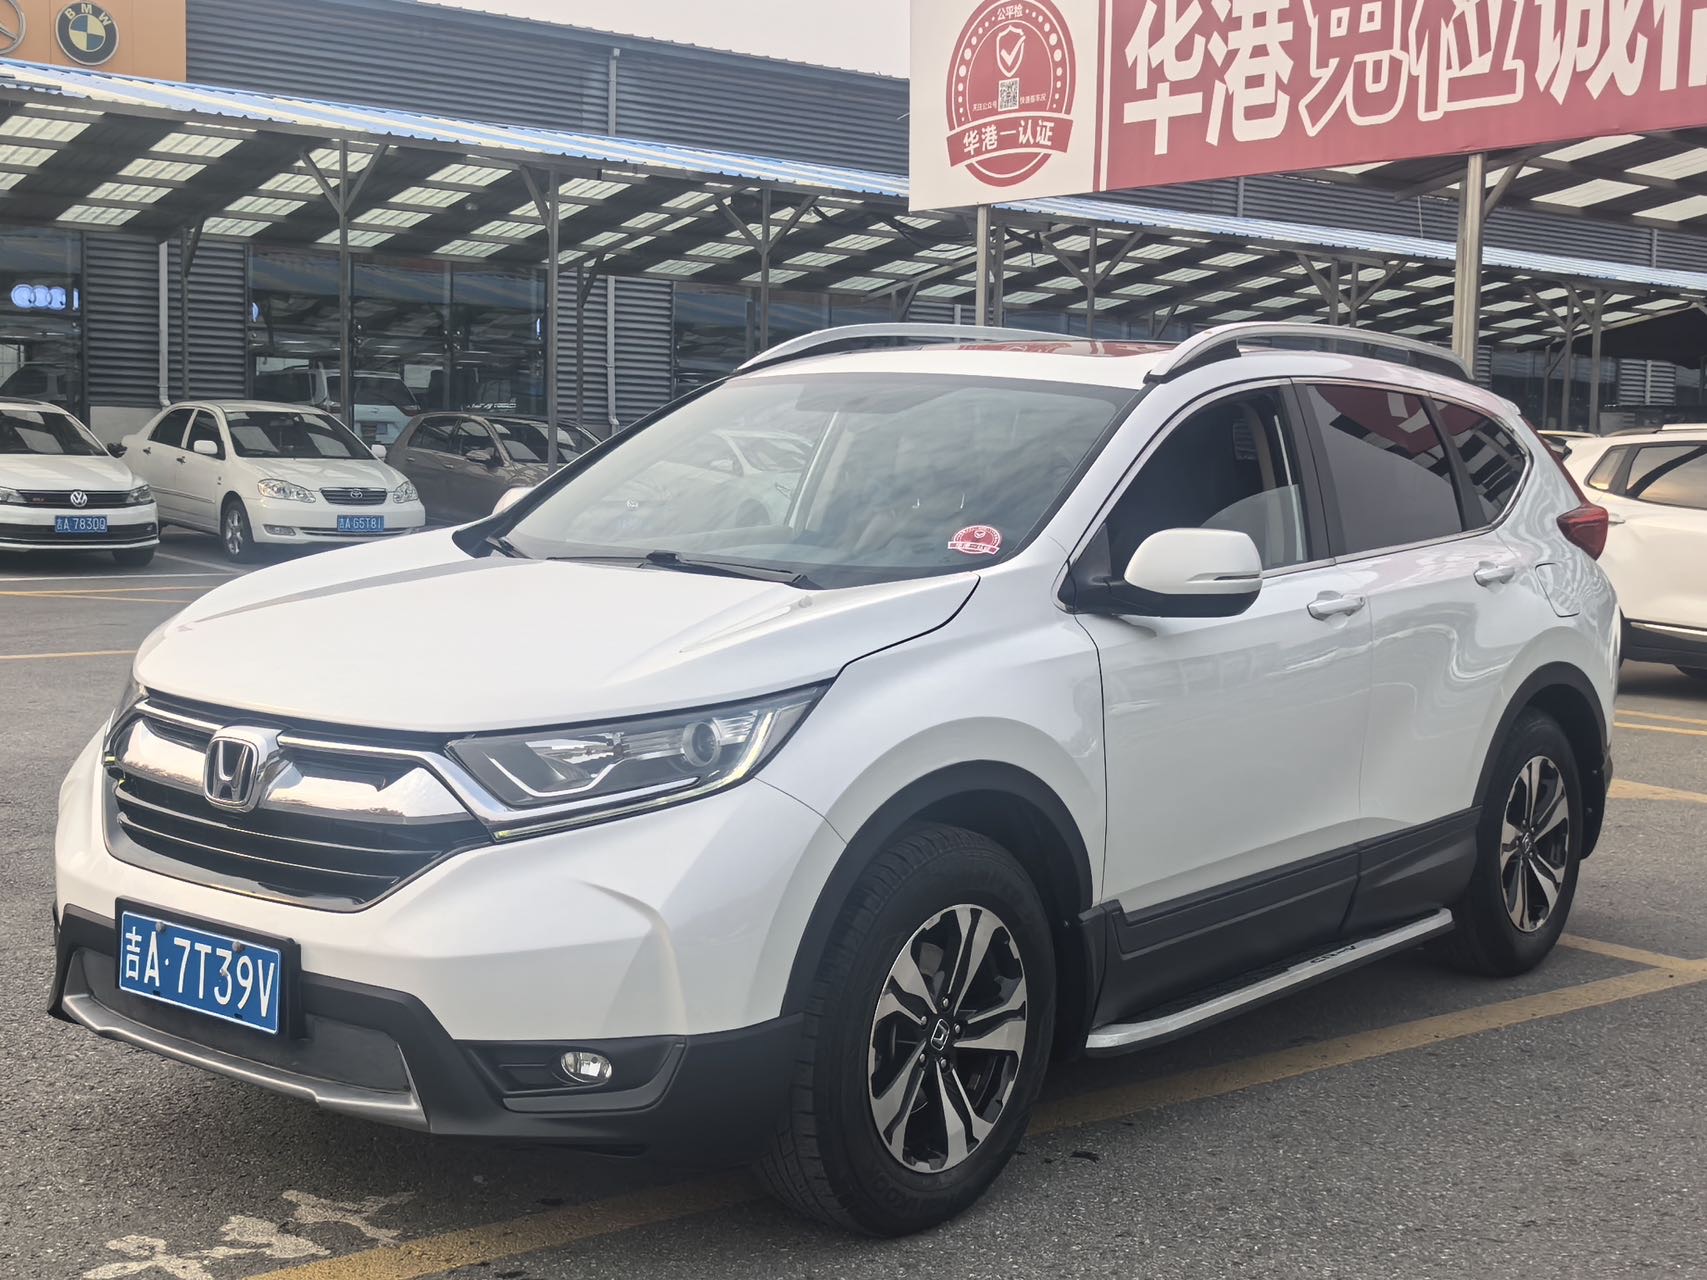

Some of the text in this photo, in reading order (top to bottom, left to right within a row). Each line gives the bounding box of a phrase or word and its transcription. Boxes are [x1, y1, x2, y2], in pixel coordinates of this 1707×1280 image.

[65, 4, 111, 26] BMW
[1123, 0, 1707, 155] 华港免检诚
